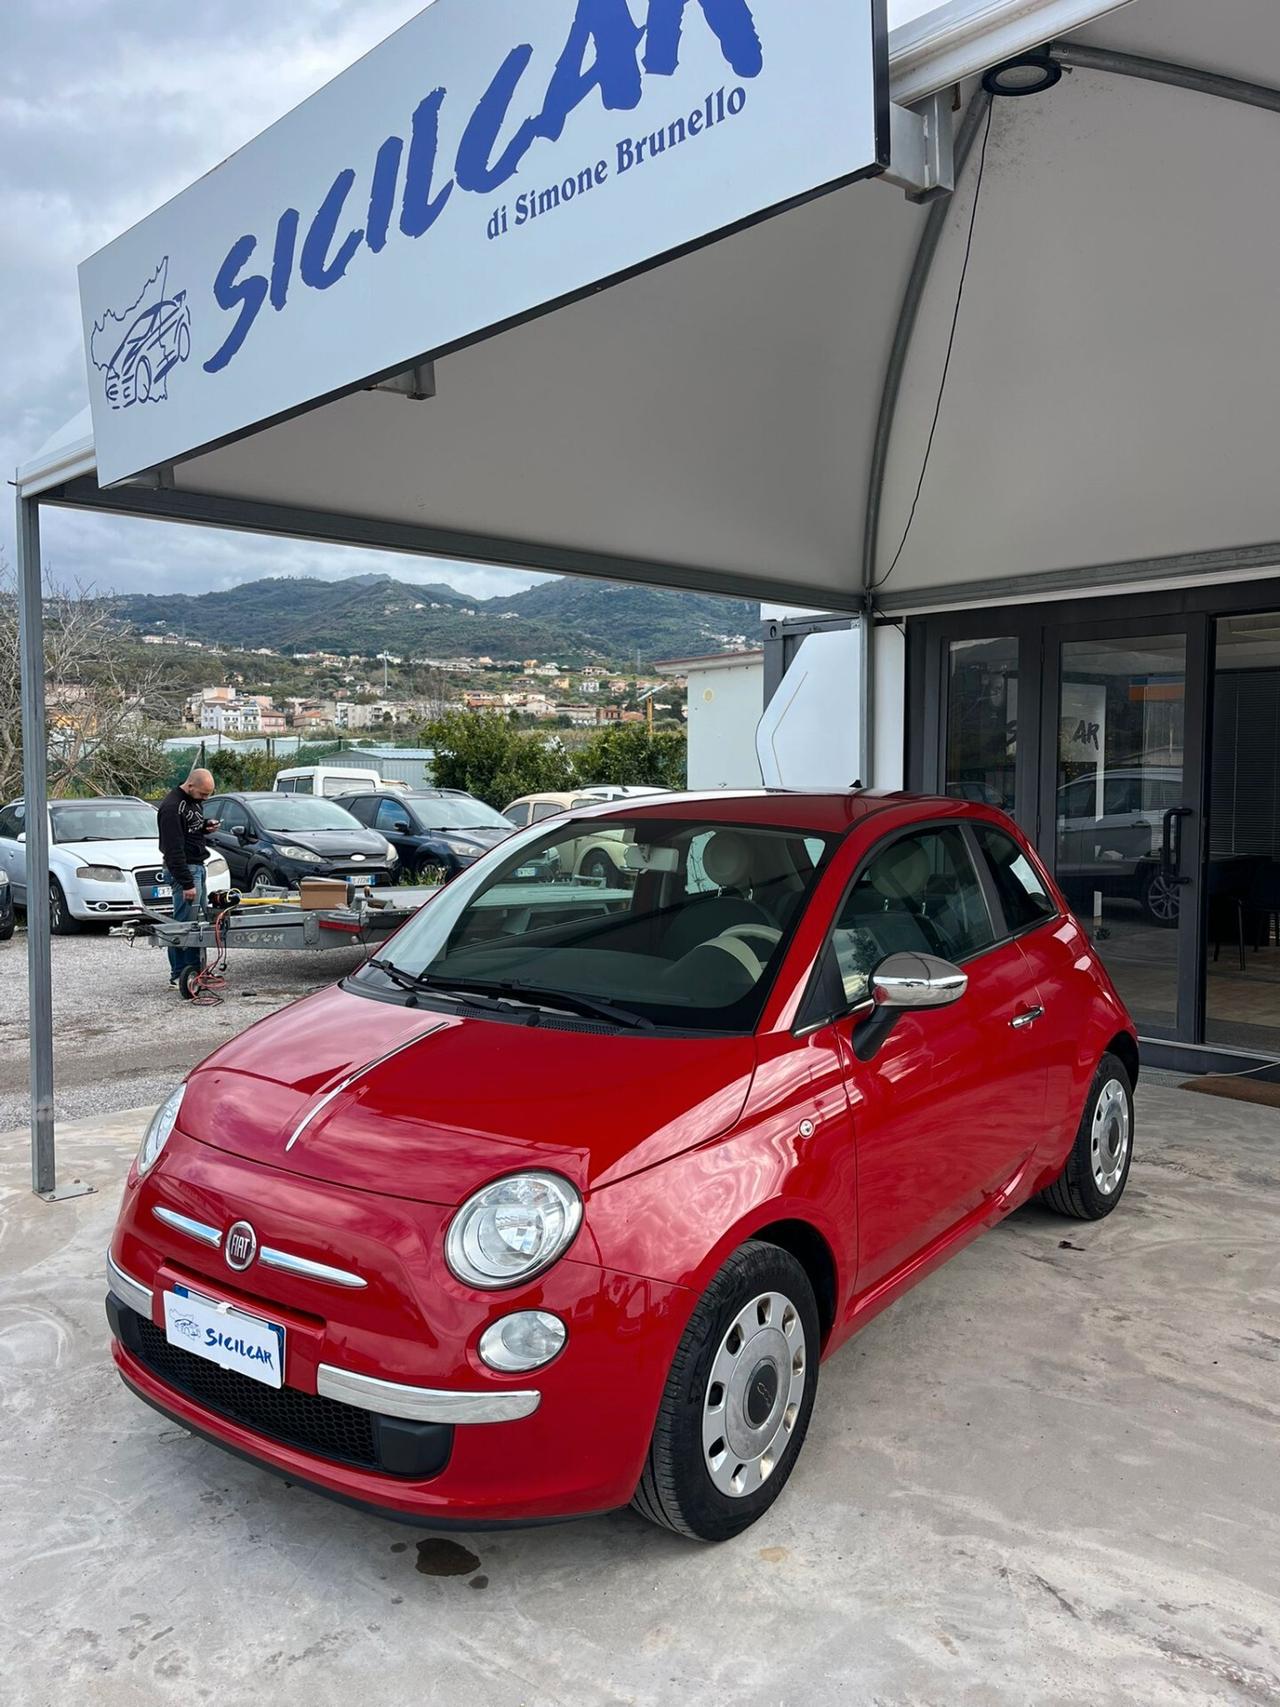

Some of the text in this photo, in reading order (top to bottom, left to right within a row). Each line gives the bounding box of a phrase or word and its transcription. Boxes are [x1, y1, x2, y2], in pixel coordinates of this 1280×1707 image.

[487, 86, 746, 240] di Simone Brunello
[231, 1234, 250, 1259] FIAT
[204, 1328, 274, 1370] SICILCAR
